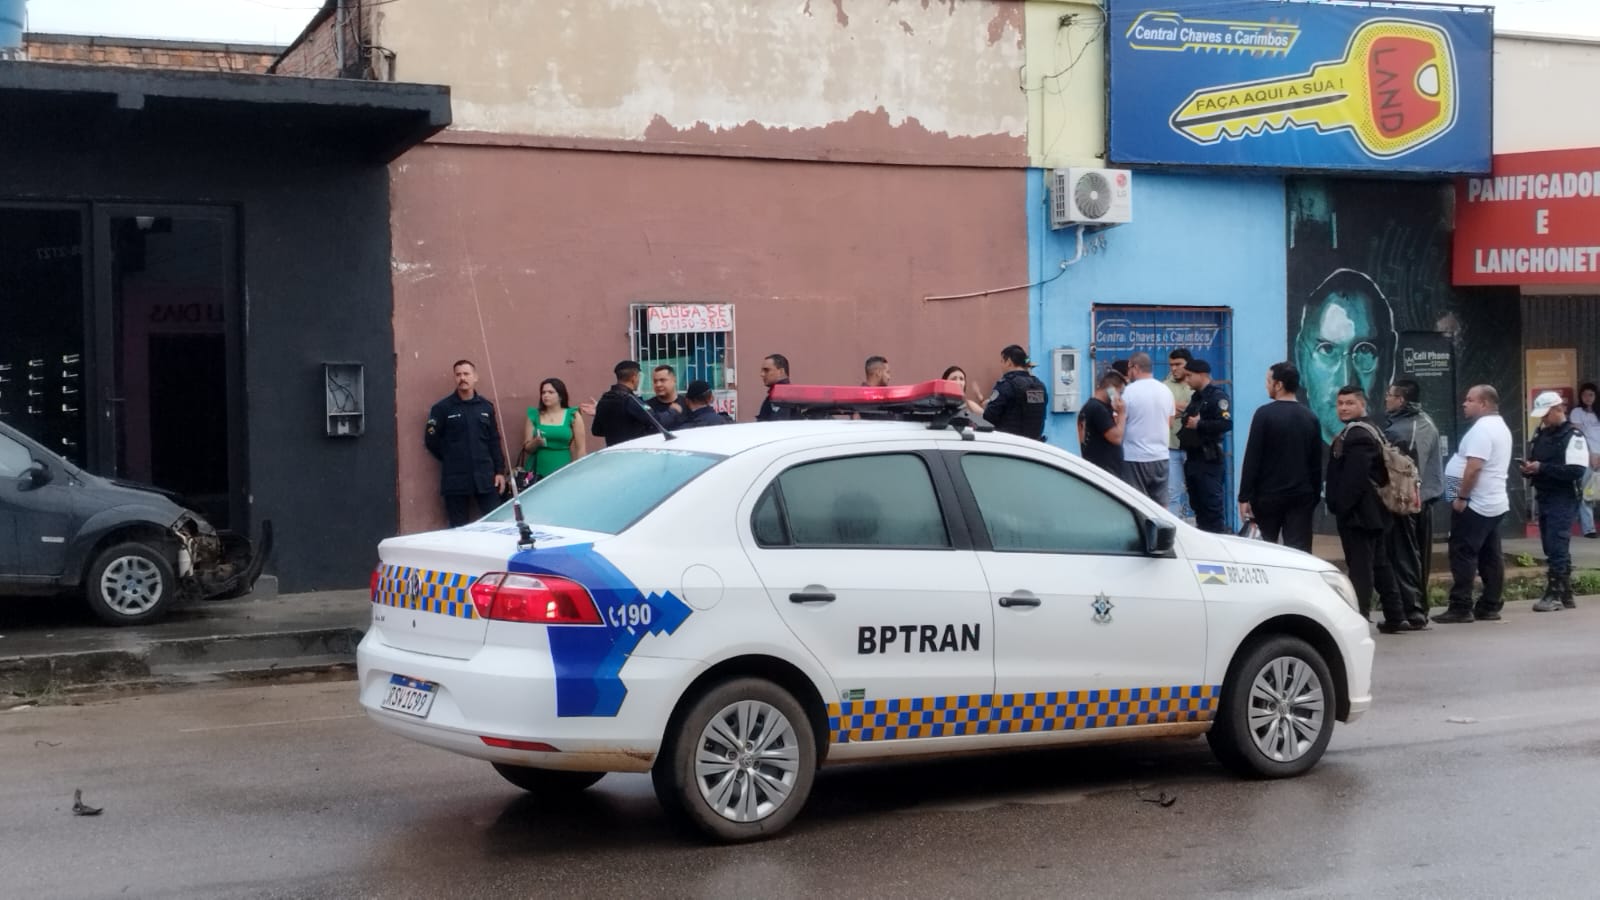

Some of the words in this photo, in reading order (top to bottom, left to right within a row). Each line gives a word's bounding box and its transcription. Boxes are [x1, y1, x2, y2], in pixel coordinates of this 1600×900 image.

[1135, 25, 1177, 41] Central
[1180, 28, 1222, 43] Chaves
[1224, 33, 1232, 43] e
[1235, 31, 1289, 46] Carimbos
[1195, 95, 1240, 112] FAÇA
[1243, 88, 1283, 104] AQUI
[1287, 85, 1299, 97] A
[1303, 81, 1335, 95] SUA
[1373, 47, 1404, 133] LAND
[1536, 209, 1549, 235] E
[1475, 246, 1600, 273] LANCHONET
[617, 603, 652, 626] 190
[857, 623, 981, 655] BPTRAN
